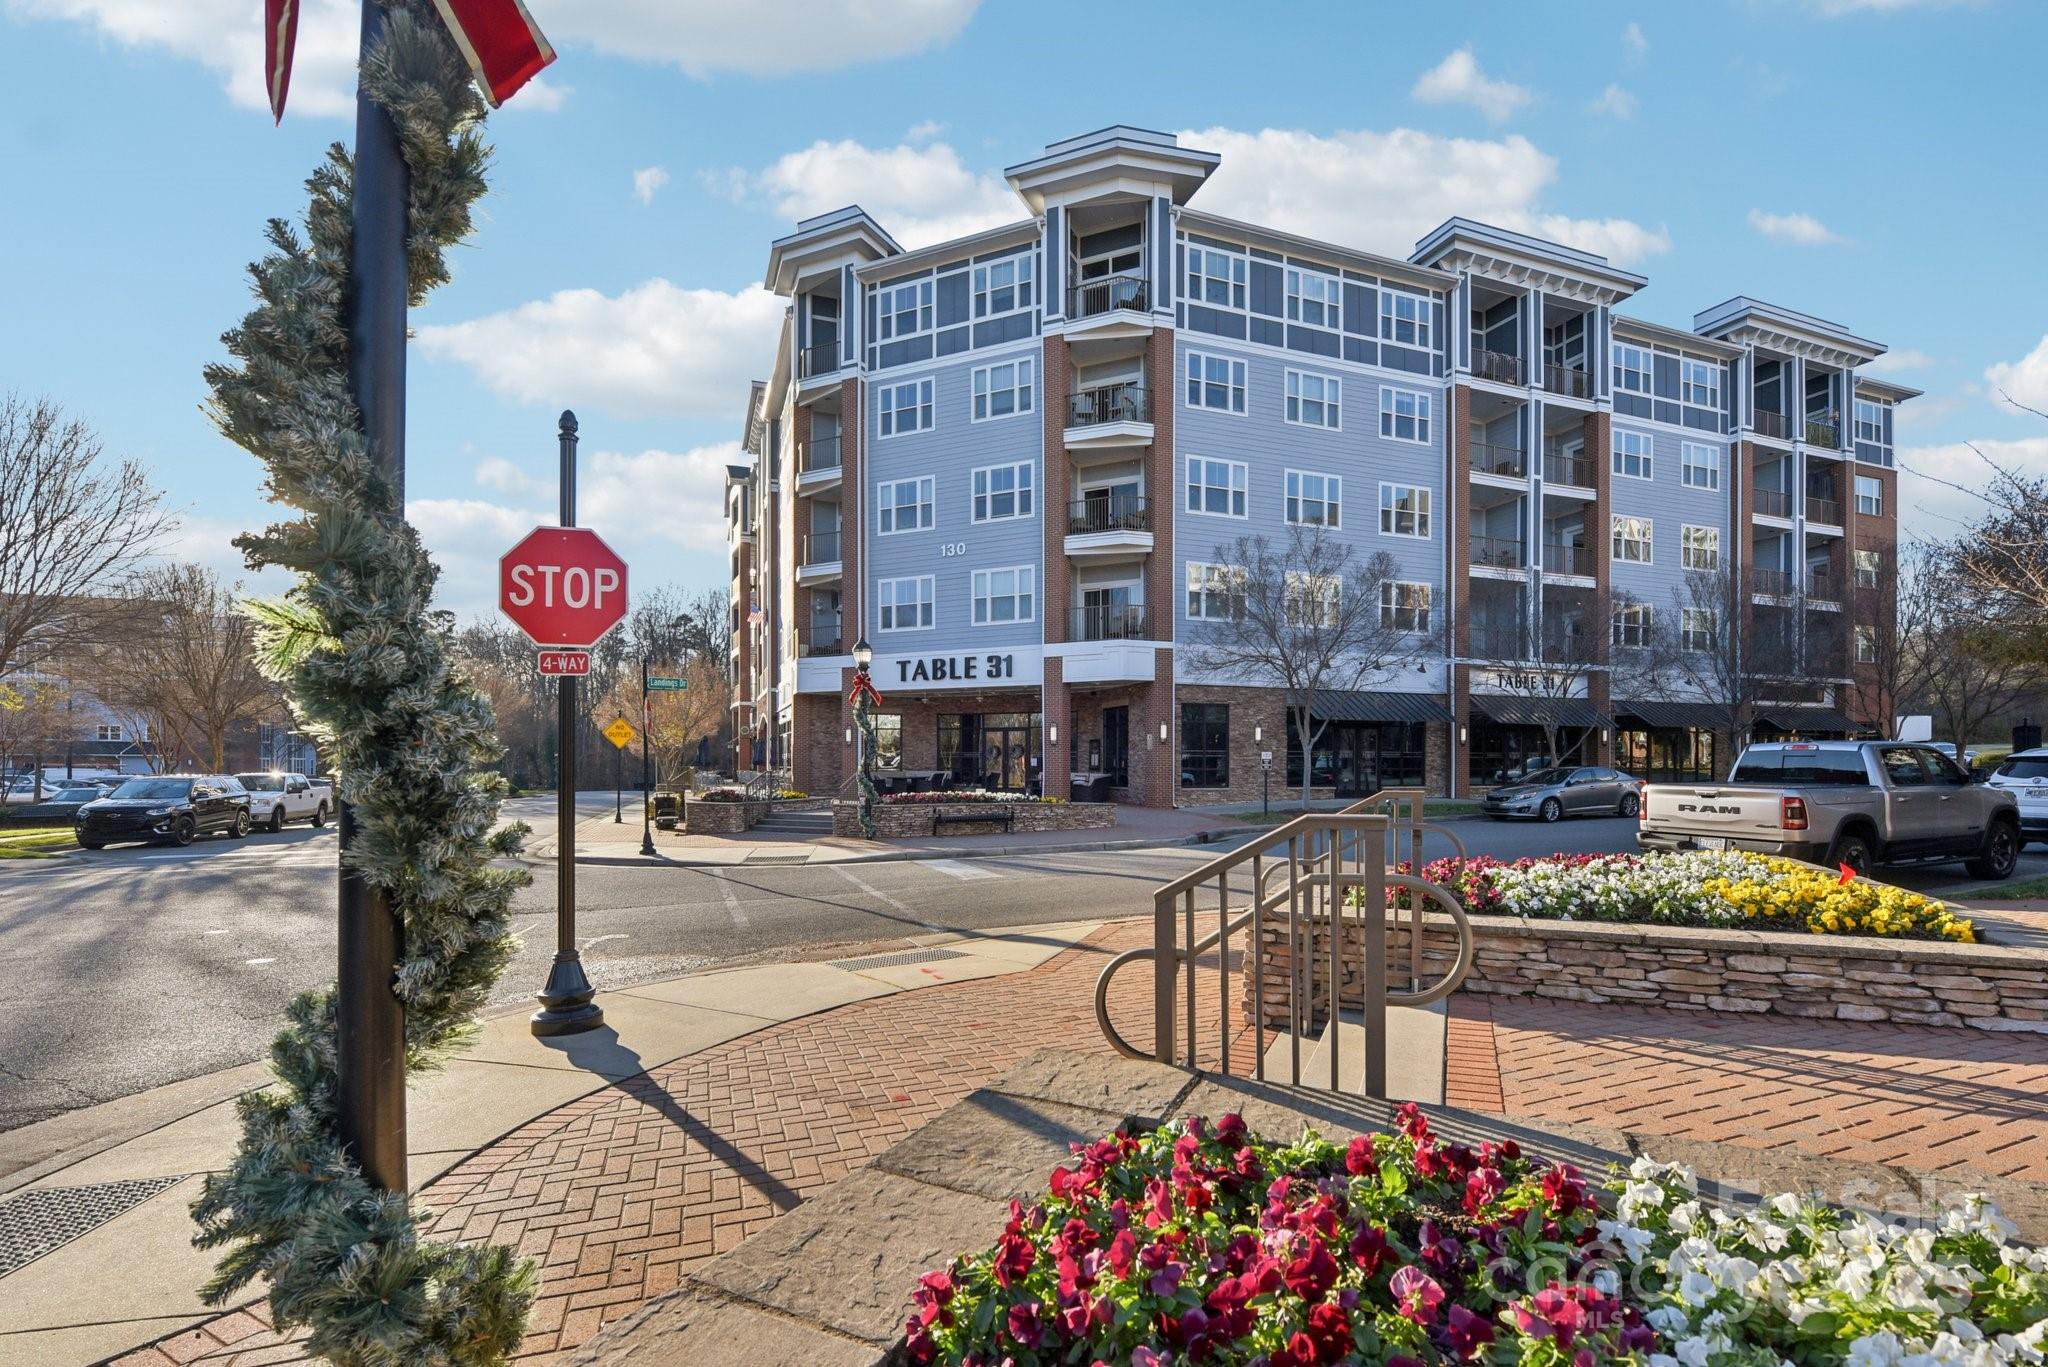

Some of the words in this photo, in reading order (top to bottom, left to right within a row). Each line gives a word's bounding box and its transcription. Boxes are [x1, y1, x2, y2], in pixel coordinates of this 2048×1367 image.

[940, 542, 966, 557] 130
[509, 564, 620, 609] STOP
[542, 656, 586, 670] 4-WAY
[896, 656, 977, 681] TABLE
[986, 654, 1013, 678] 31
[650, 679, 678, 688] Landings
[1497, 674, 1537, 690] TABLE
[1678, 804, 1741, 815] RAM
